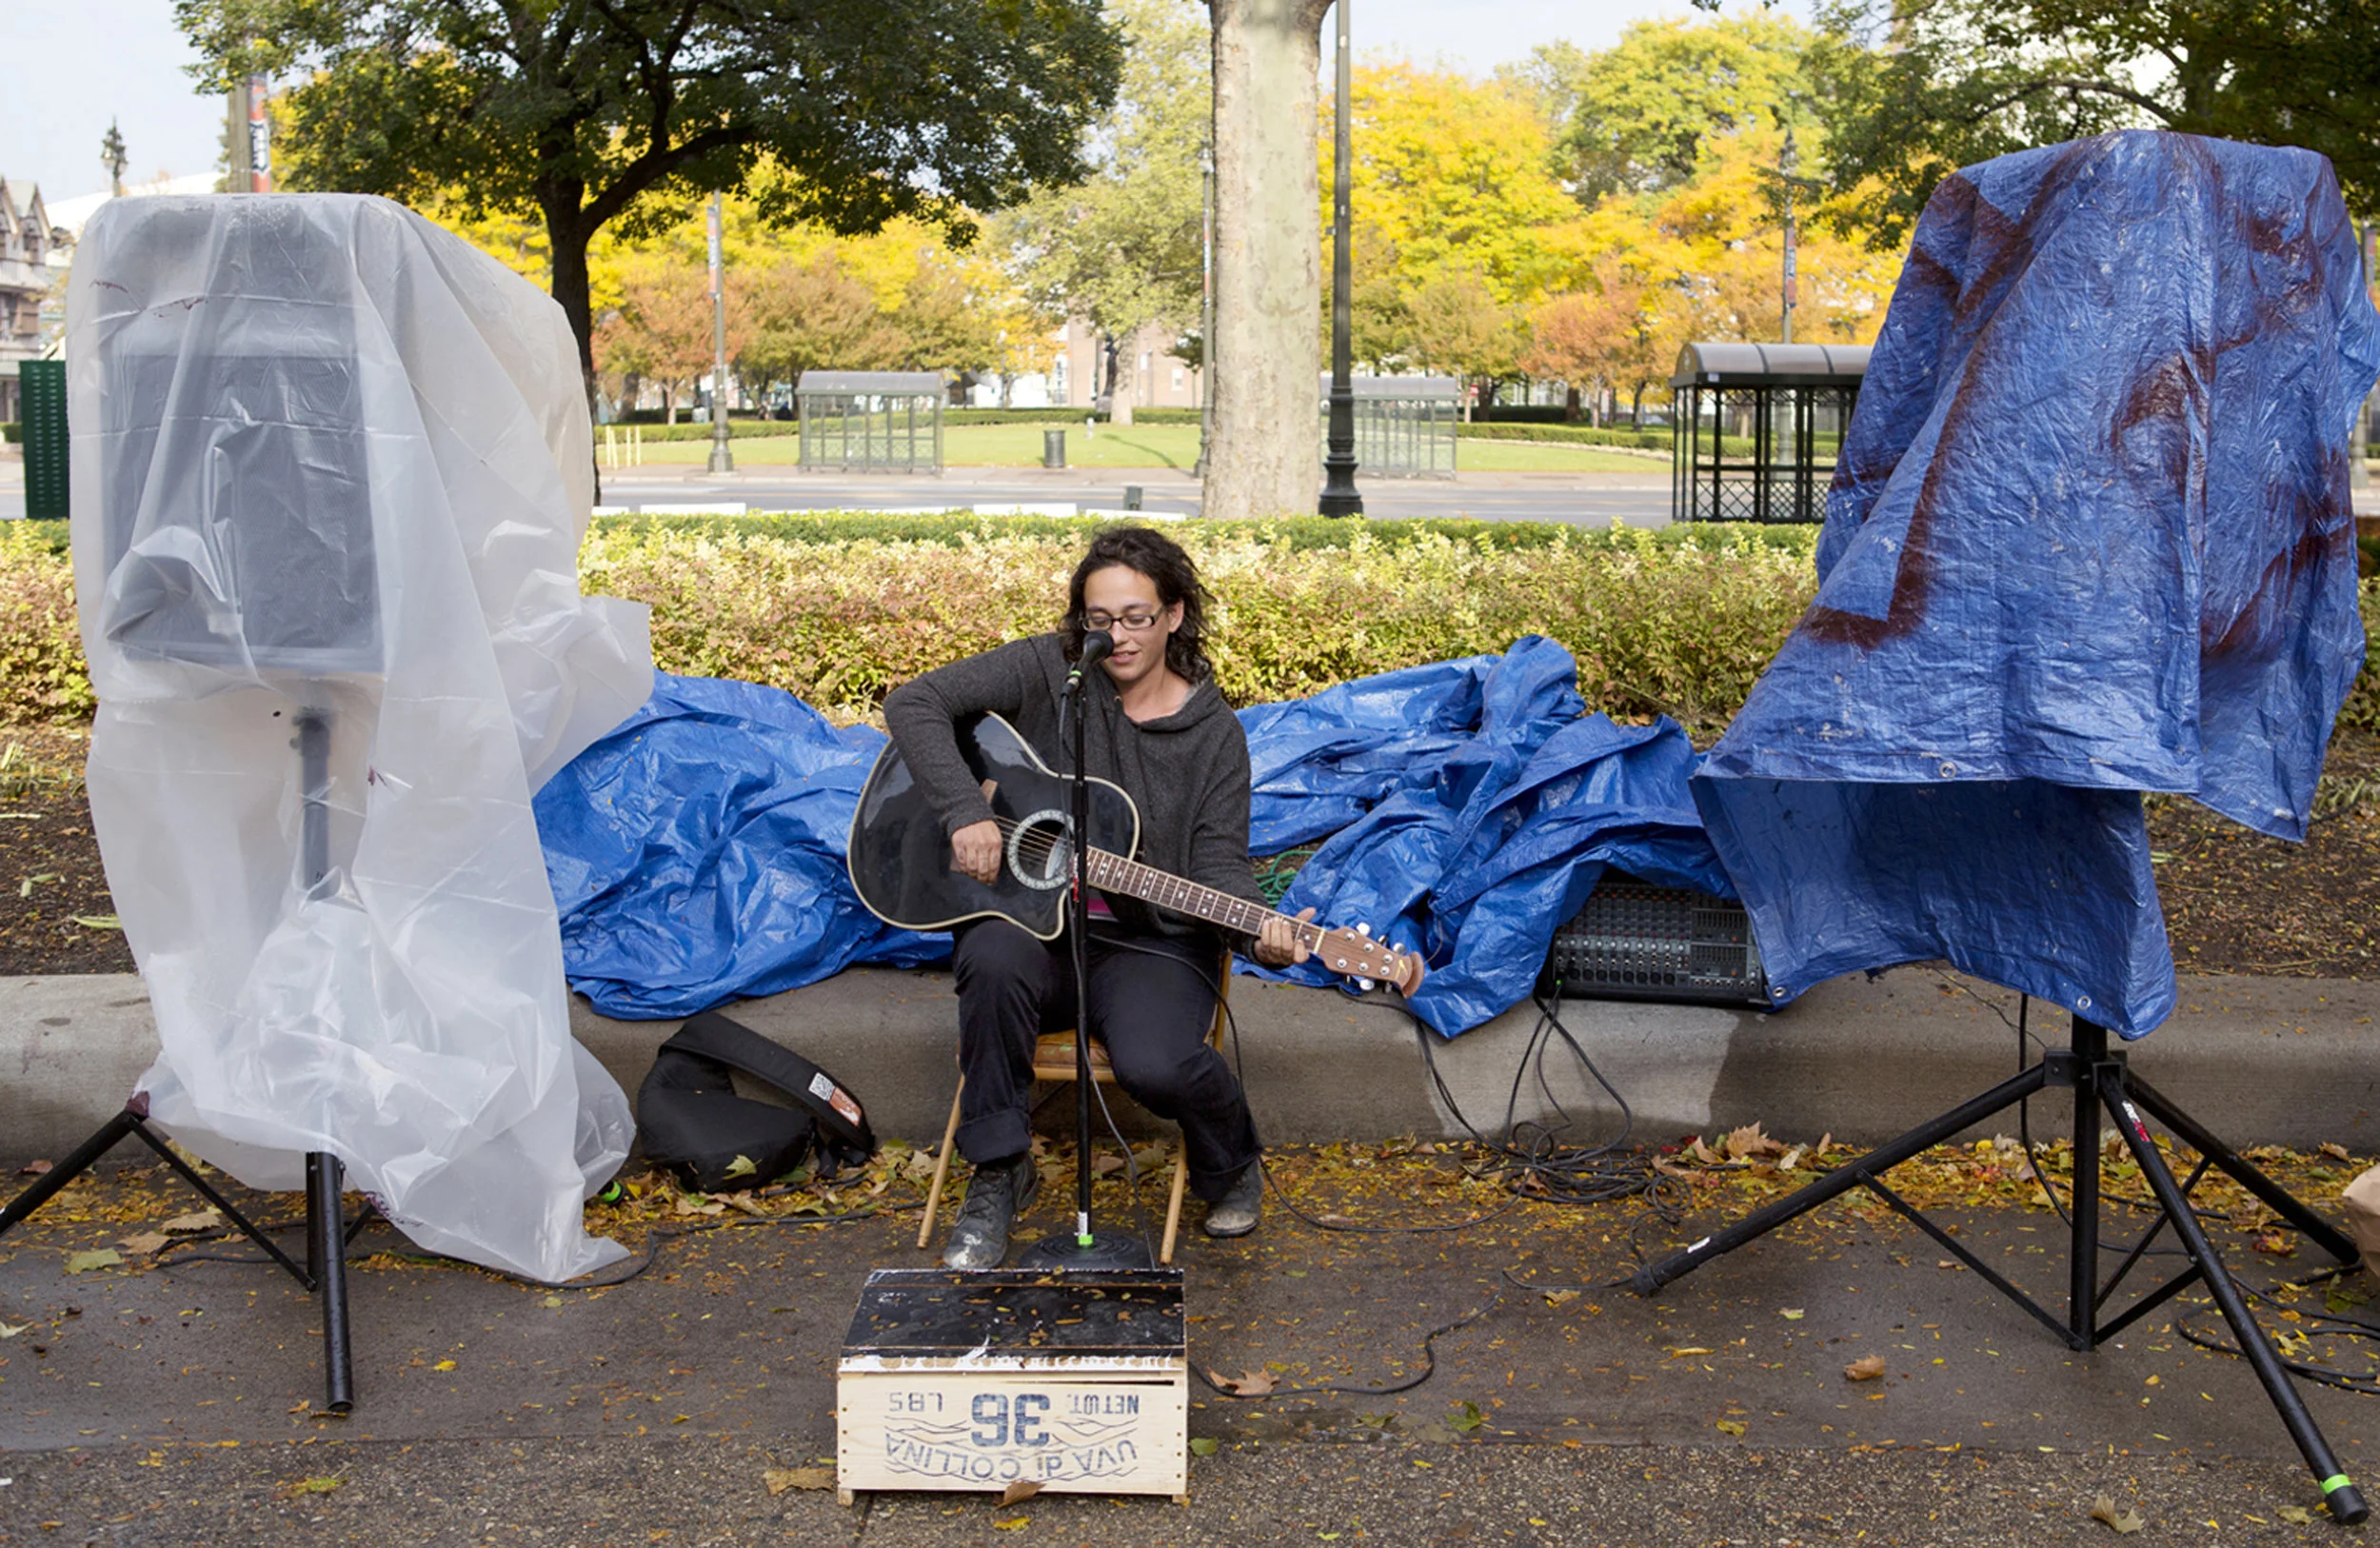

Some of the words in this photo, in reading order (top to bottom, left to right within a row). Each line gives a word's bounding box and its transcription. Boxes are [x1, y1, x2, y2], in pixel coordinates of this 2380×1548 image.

[888, 1392, 943, 1412] LBS
[970, 1393, 1051, 1447] 36
[884, 1432, 1021, 1479] COLLINA
[1037, 1454, 1062, 1479] di
[1072, 1439, 1139, 1472] UVA
